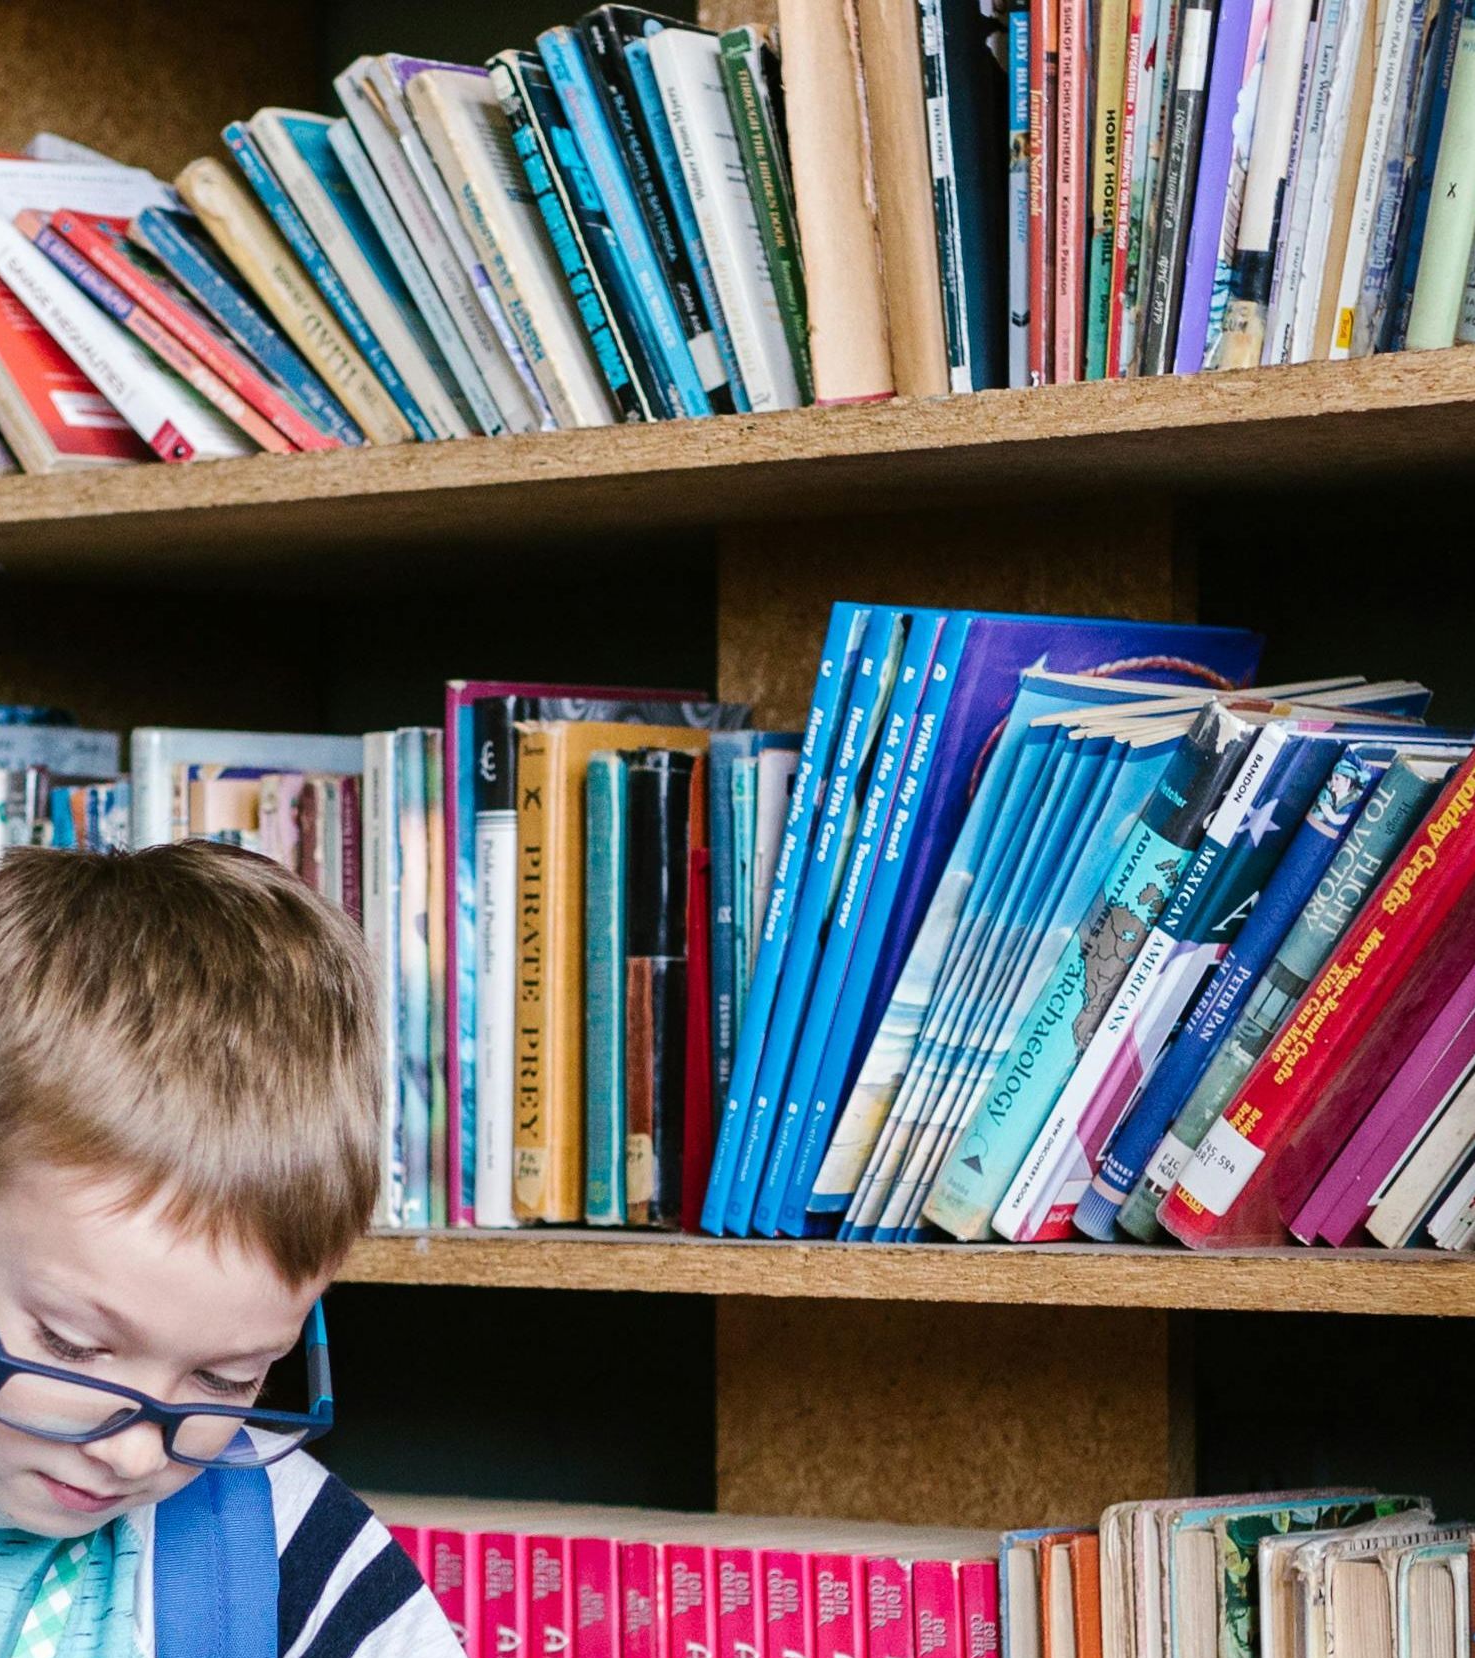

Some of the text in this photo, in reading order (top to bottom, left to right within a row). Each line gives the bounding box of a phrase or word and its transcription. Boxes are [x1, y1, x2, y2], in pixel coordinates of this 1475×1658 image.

[1012, 18, 1029, 122] JUDY BLUME
[1058, 6, 1073, 183] SIGN OF THE CHRYSANTHEMUM
[1307, 43, 1335, 134] Larry Weinberg
[1439, 9, 1462, 89] Adventure
[1100, 109, 1118, 265] HOBBY HORSE HILL
[1058, 196, 1070, 295] Katherine Paterson
[801, 706, 825, 757] Many
[1231, 751, 1264, 805] BANDON
[815, 705, 864, 863] Handle With Care
[835, 713, 906, 928] Ask Me Again Tomorrow
[882, 710, 936, 863] Within My Reach
[1383, 799, 1414, 839] Hough
[774, 831, 798, 883] Many
[1088, 827, 1153, 940] ADVENTURES
[1161, 843, 1218, 930] MEXICAN
[1297, 780, 1396, 933] TO VICTORY
[1314, 848, 1382, 945] FLIGHT
[1380, 840, 1441, 920] Crafts
[761, 886, 786, 941] Voices
[518, 844, 541, 1137] PIRATE PREY
[1105, 934, 1168, 1035] AMERICANS
[1198, 963, 1251, 1045] PETER PAN
[1270, 962, 1344, 1065] Kids Can Make
[1272, 925, 1387, 1088] More Year-Round Crafts
[1011, 1115, 1066, 1210] NEW DISCOVERY BOOKS
[1162, 1153, 1181, 1170] FIC
